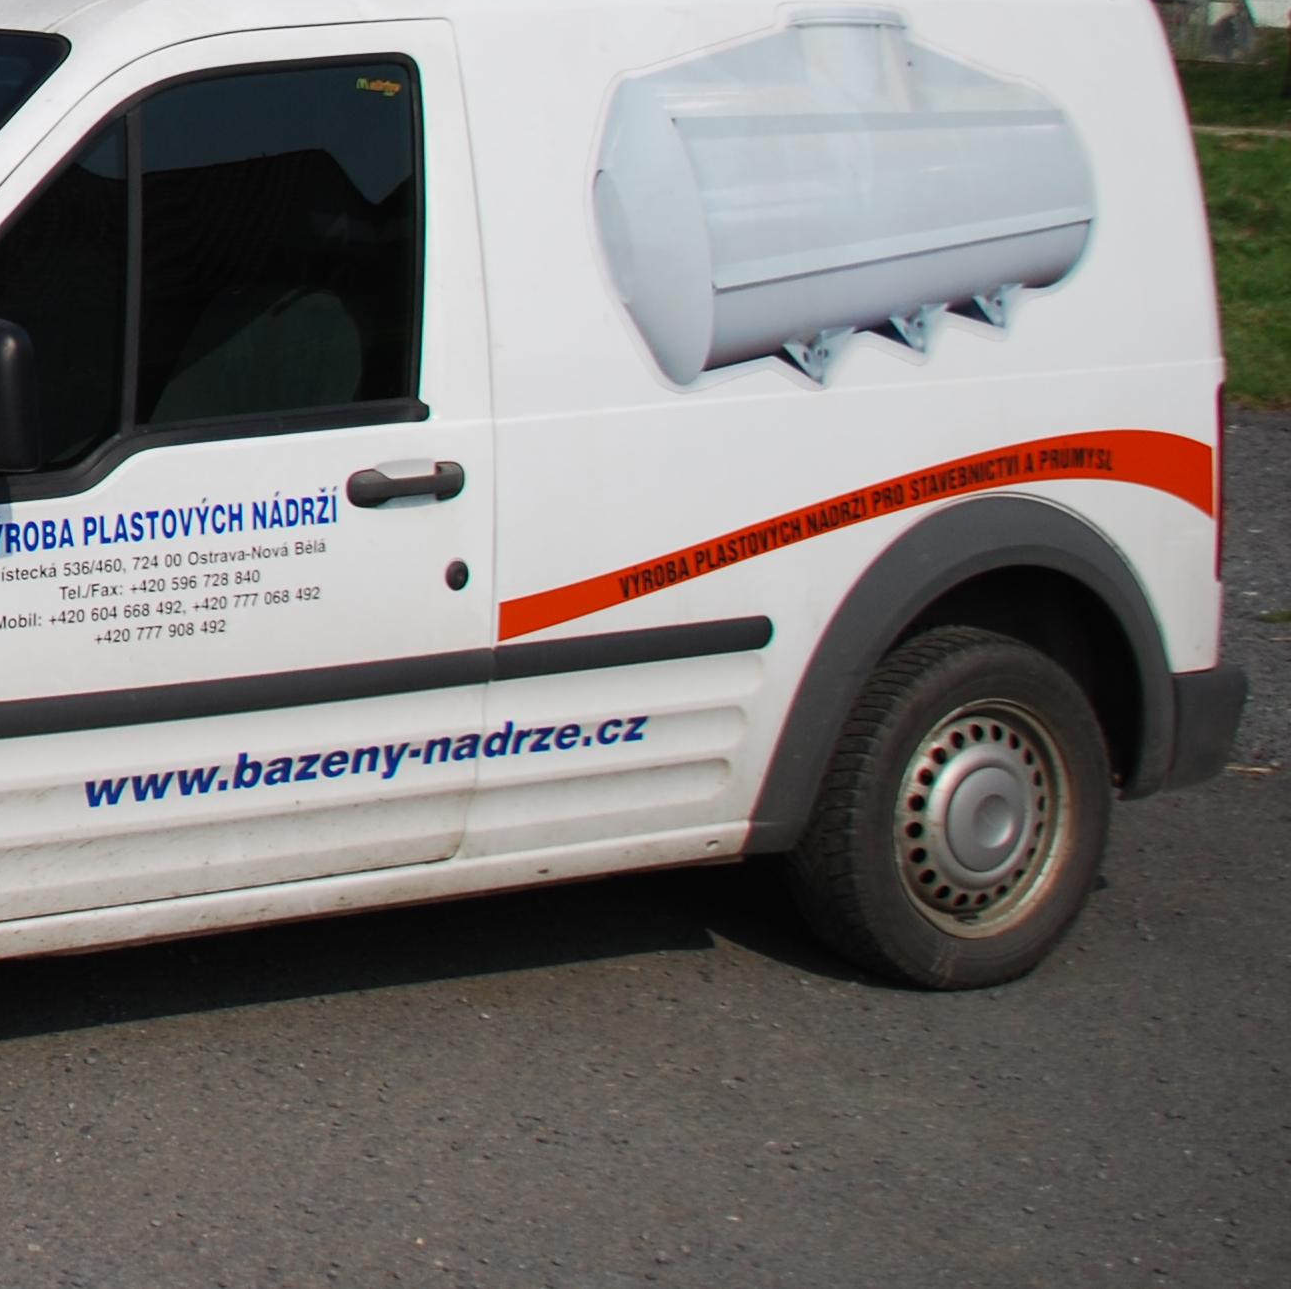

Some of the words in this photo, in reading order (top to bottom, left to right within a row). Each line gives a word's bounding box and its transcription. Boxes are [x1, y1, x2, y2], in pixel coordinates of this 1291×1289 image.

[83, 496, 244, 547] PLASTOVÝCH
[251, 485, 338, 531] NÁDRŽÍ
[619, 555, 690, 599] VÝROBA
[695, 517, 802, 574] PLASTOVÝCH
[872, 484, 905, 511] PRO
[1024, 452, 1035, 474] A
[62, 557, 127, 578] 536/460,
[132, 555, 159, 571] 724
[164, 552, 182, 568] 00
[187, 541, 289, 566] Ostrava-Nová
[294, 538, 327, 556] Bělá
[59, 581, 124, 601] Tel./Fax:
[130, 577, 166, 595] +420
[171, 575, 197, 591] 596
[203, 572, 229, 588] 728
[234, 569, 261, 585] 840
[48, 608, 85, 626] +420
[91, 605, 118, 622] 604
[123, 603, 150, 619] 668
[155, 599, 187, 616] 492,
[192, 595, 227, 612] +420
[233, 592, 259, 608] 777
[264, 589, 290, 606] 068
[295, 586, 321, 602] 492
[94, 627, 131, 645] +420
[136, 625, 163, 641] 777
[168, 622, 195, 638] 908
[199, 618, 227, 635] 492
[84, 714, 649, 808] www.bazeny-nadrze.cz
